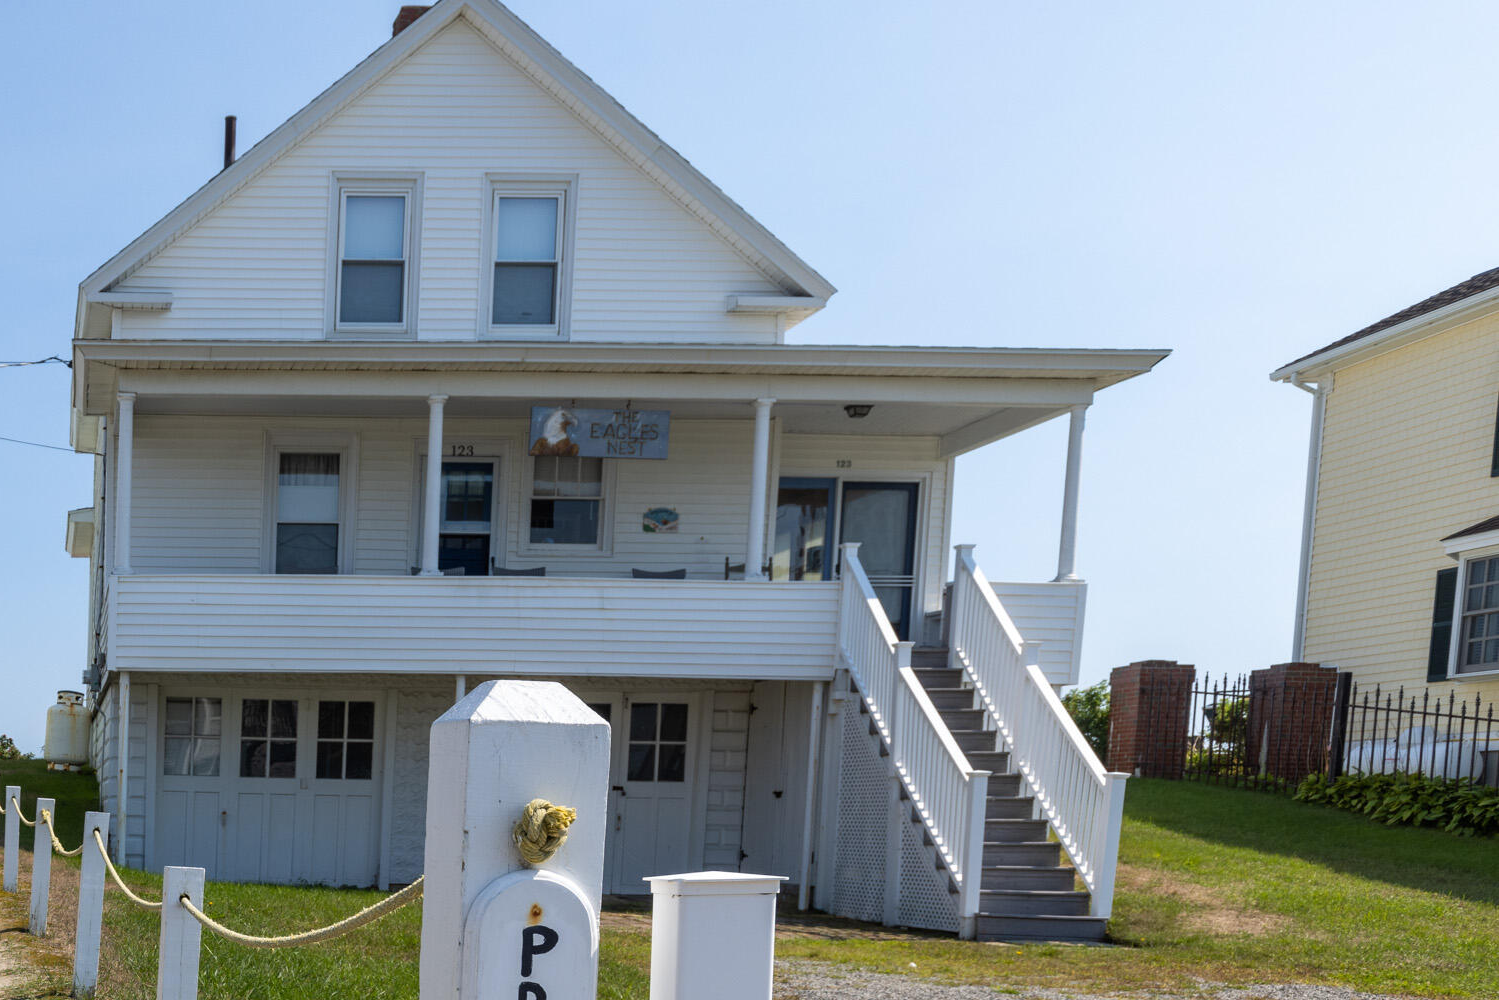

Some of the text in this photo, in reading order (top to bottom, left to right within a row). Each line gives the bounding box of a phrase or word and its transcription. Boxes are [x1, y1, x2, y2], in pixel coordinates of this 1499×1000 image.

[613, 411, 639, 423] THE
[452, 445, 474, 457] 123
[606, 440, 647, 457] NEST
[836, 460, 852, 469] 123
